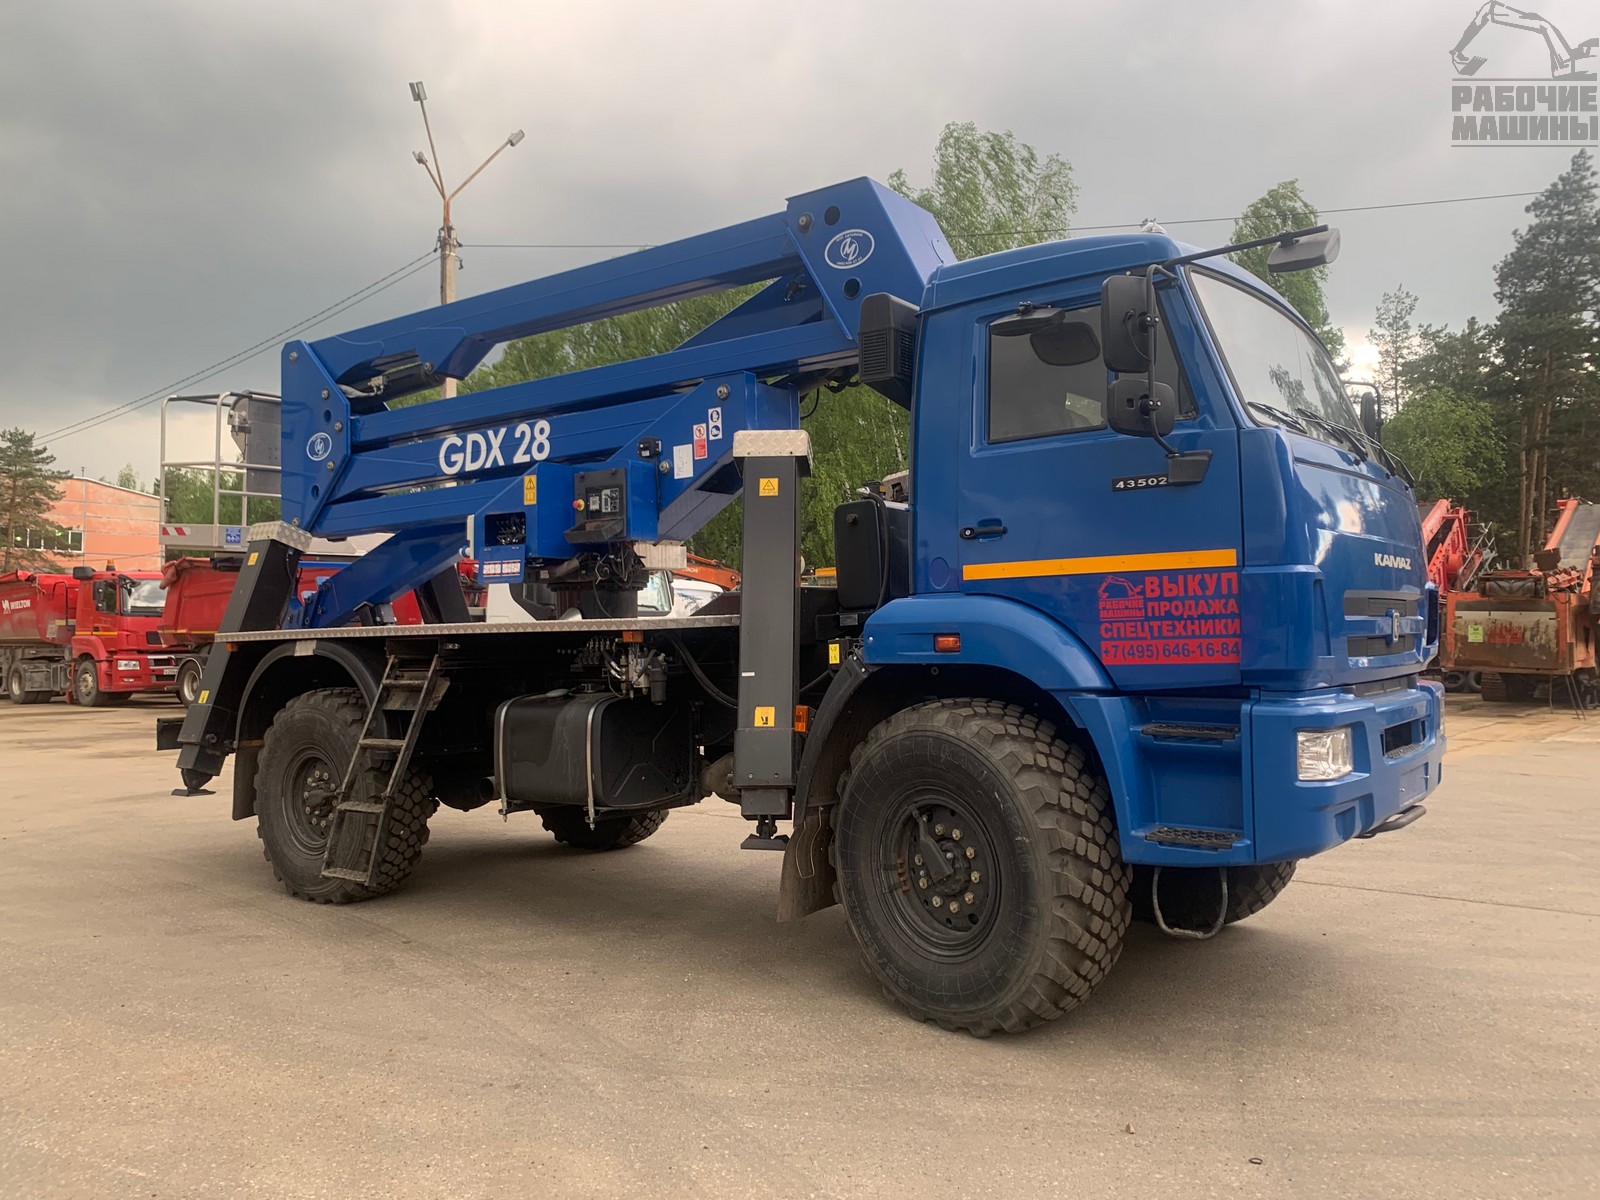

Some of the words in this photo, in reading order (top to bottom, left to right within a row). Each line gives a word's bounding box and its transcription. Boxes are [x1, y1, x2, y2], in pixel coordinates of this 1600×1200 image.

[439, 427, 508, 475] GDX
[513, 419, 551, 464] 28
[1115, 476, 1168, 489] 43502
[1374, 552, 1412, 571] KAMAZ
[1144, 572, 1239, 598] ВЫКУП
[1147, 598, 1240, 618] ПРОДАЖА
[1099, 618, 1241, 640] СПЕЦТЕХНИКИ
